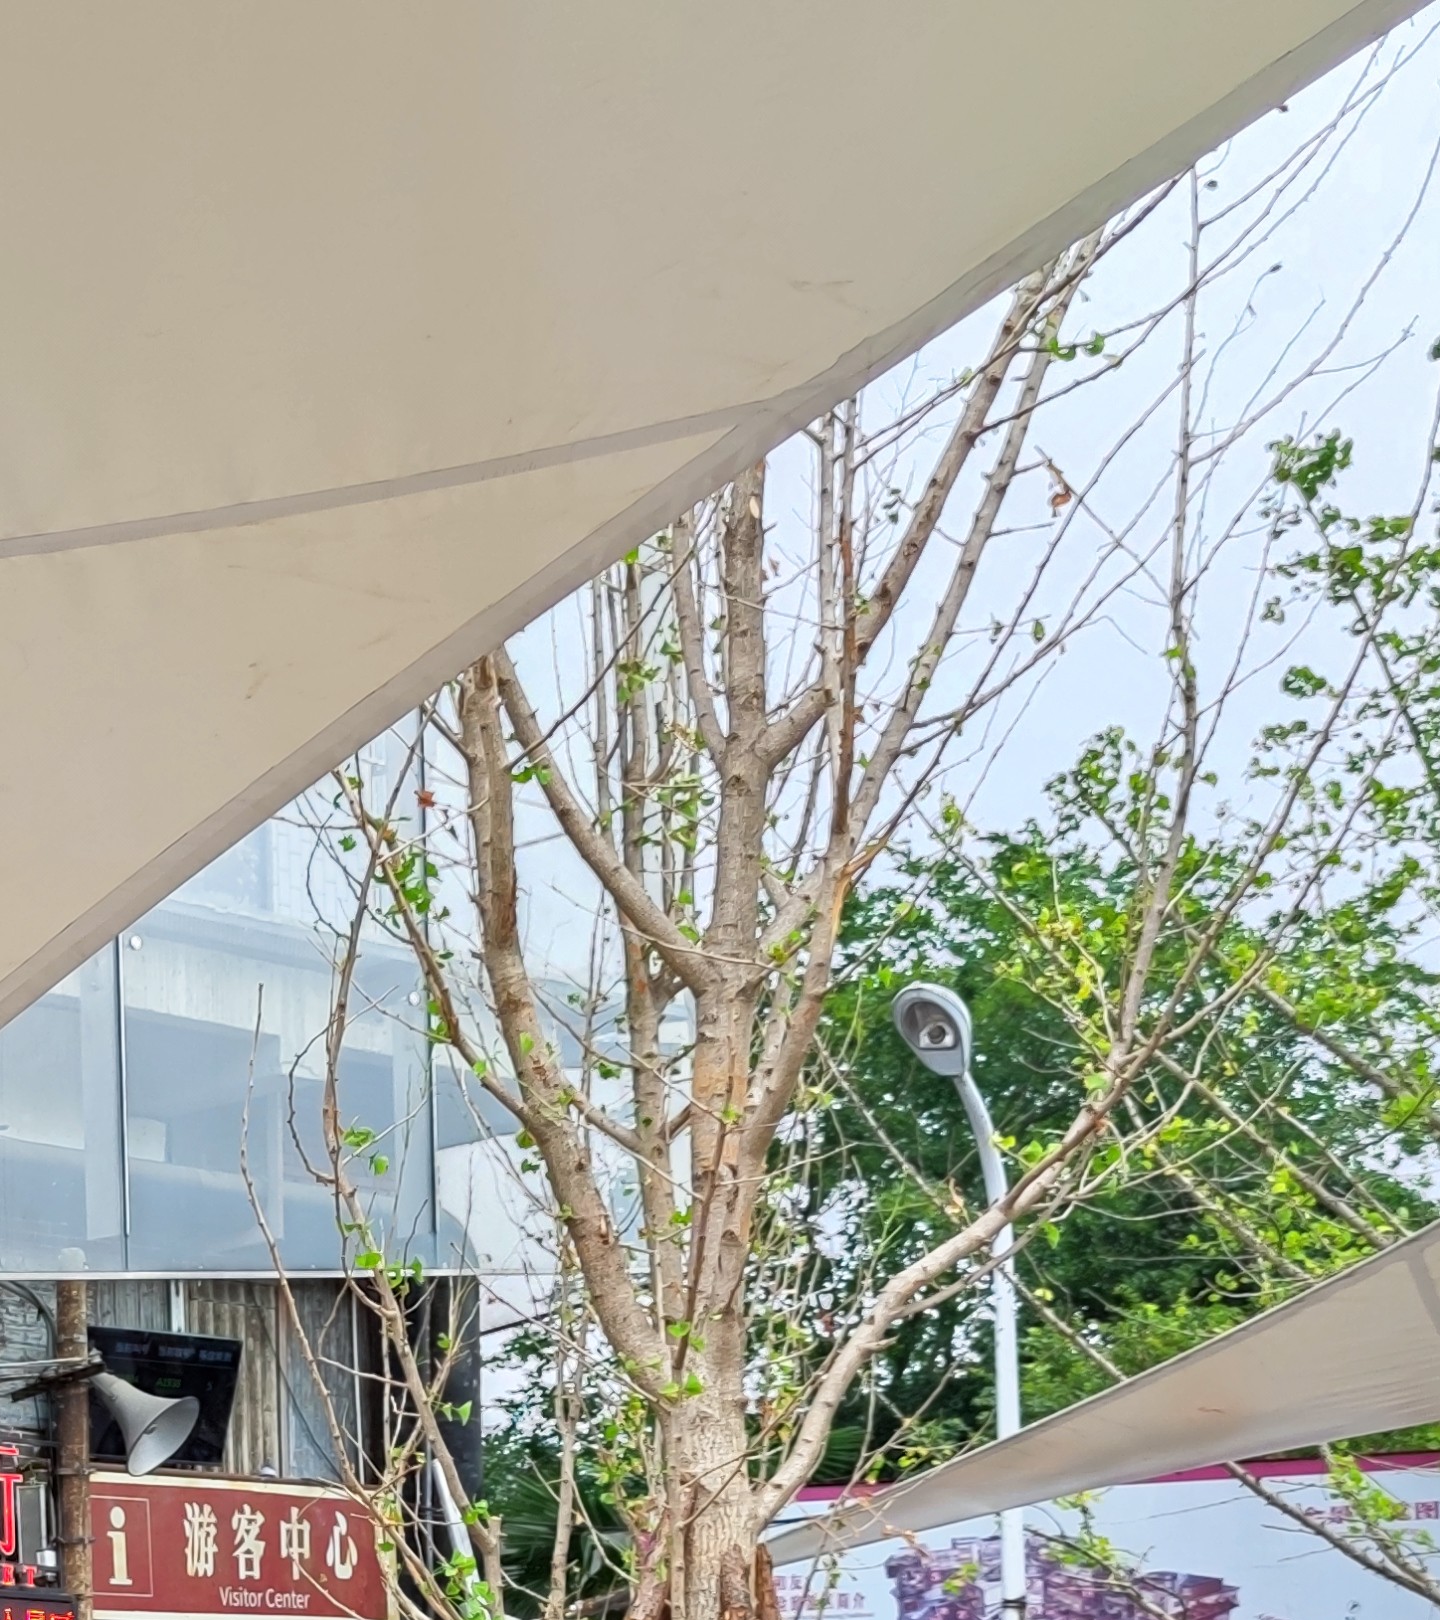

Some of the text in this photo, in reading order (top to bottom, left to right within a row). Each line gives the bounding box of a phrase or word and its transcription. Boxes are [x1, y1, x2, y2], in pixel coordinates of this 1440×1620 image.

[183, 1502, 359, 1581] 游客中心
[219, 1586, 310, 1609] Visitor Center
